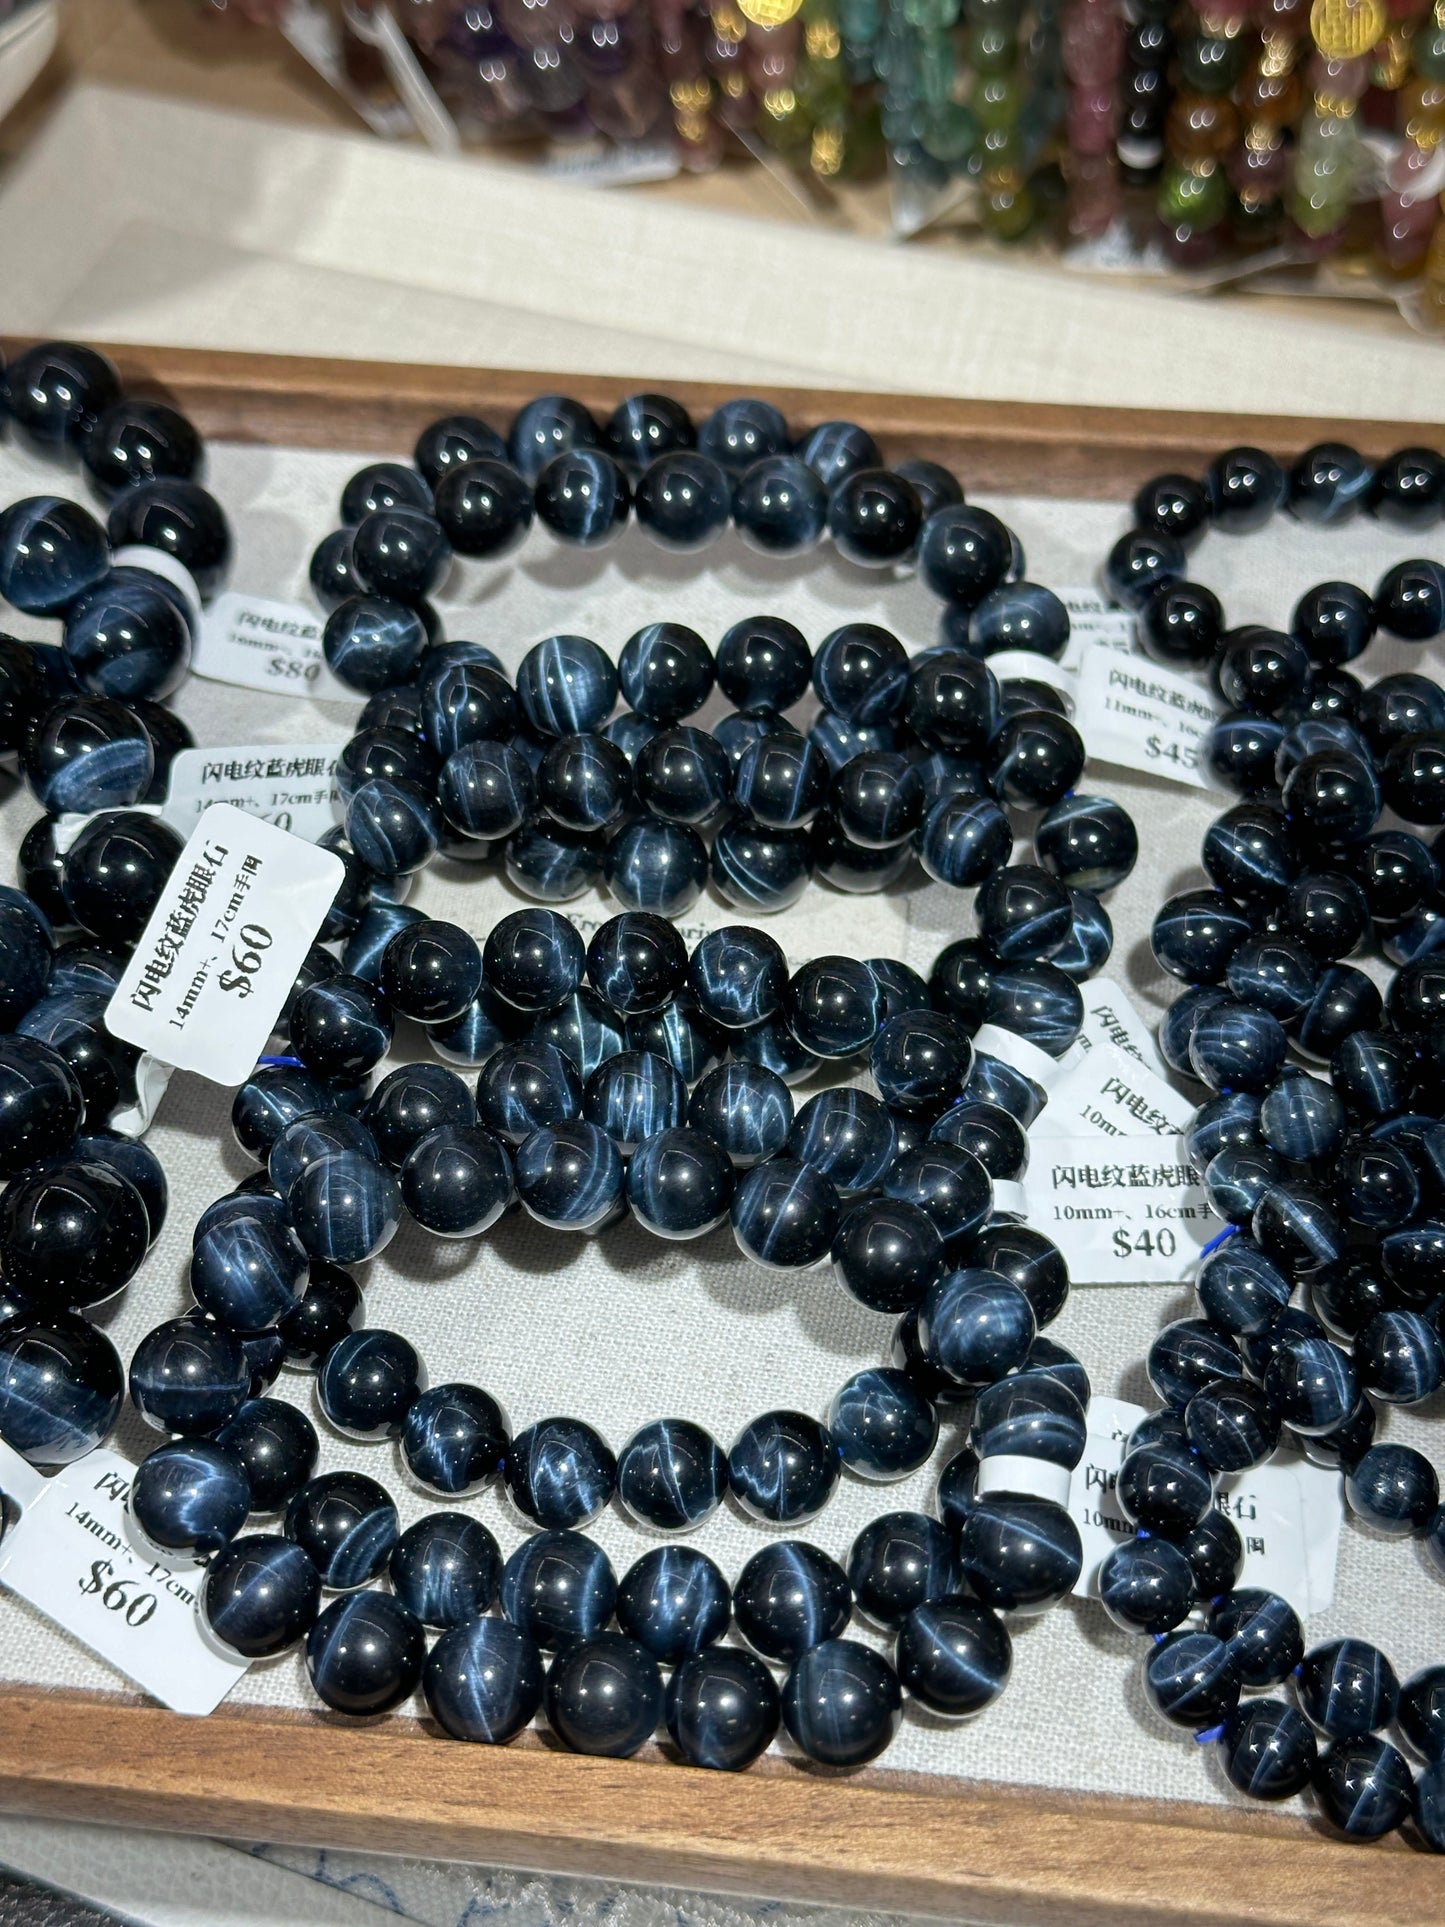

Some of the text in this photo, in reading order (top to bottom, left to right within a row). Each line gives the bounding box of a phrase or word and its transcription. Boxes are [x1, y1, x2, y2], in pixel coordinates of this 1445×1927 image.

[266, 656, 321, 683] $80
[1144, 734, 1199, 770] $45
[216, 924, 273, 999] $60
[1079, 1104, 1128, 1137] 10m
[1051, 1164, 1201, 1189] 闪电纹蓝虎眼
[1111, 1225, 1177, 1259] $40
[78, 1558, 158, 1627] $60
